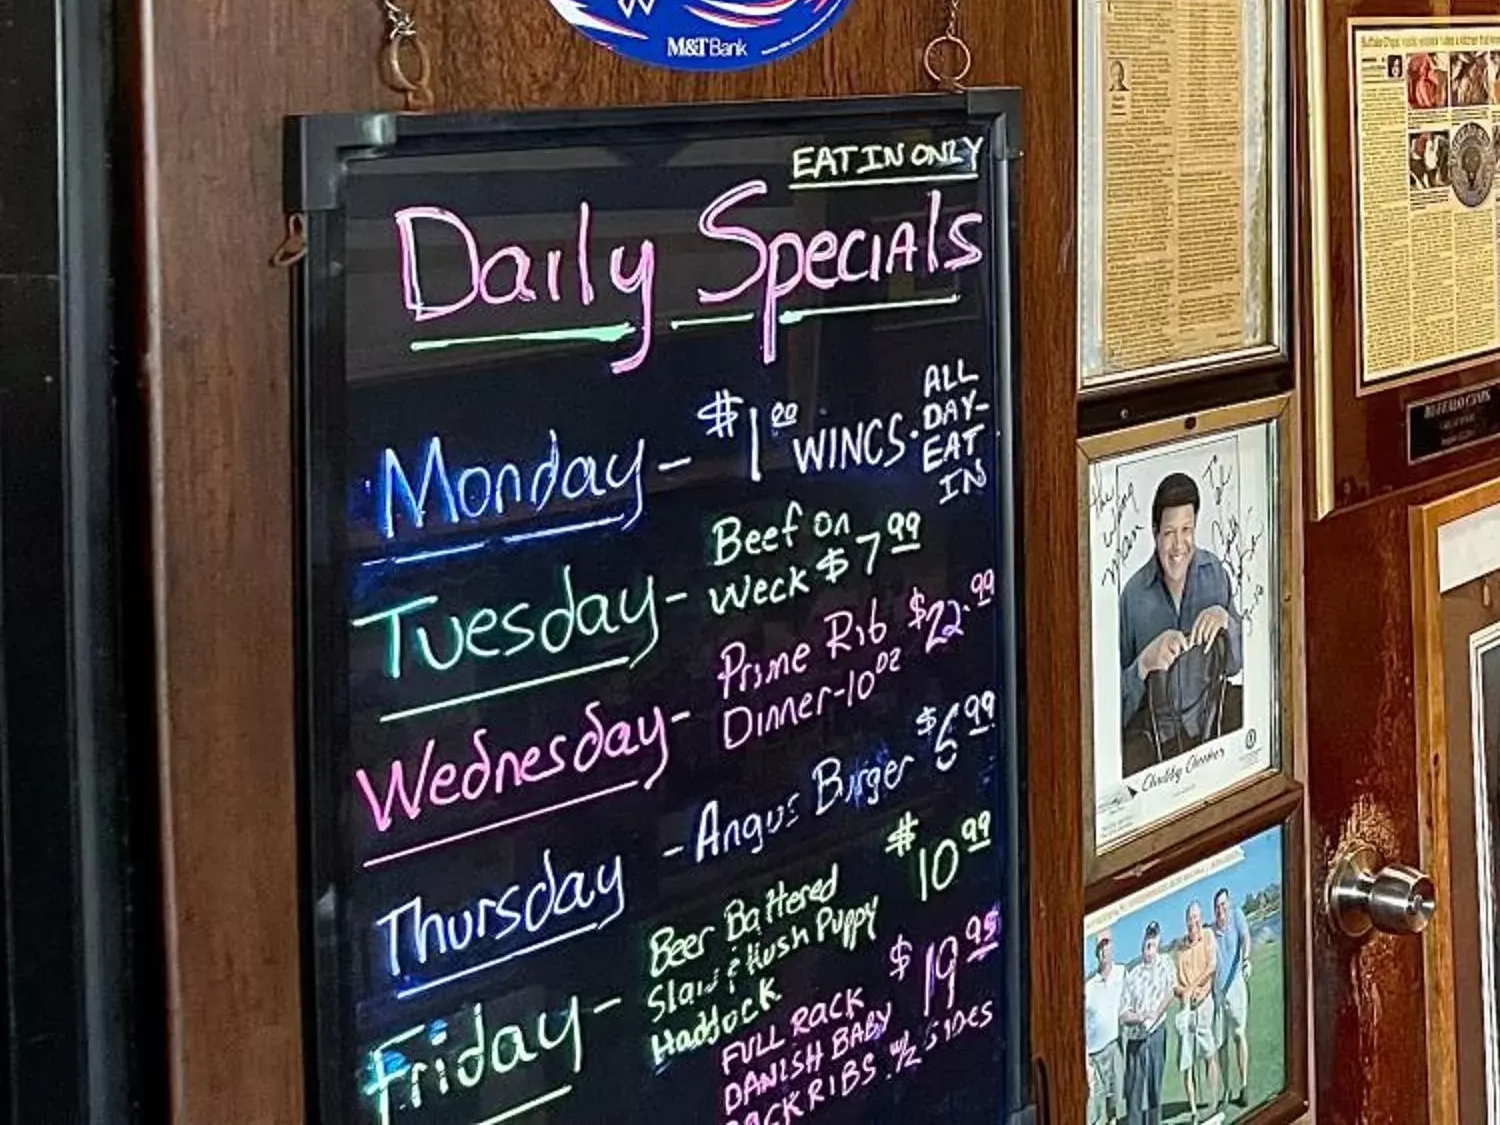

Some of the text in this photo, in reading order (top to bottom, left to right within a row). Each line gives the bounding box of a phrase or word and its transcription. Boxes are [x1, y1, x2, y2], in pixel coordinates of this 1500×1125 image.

[667, 37, 748, 57] M&T Bank
[792, 136, 985, 178] EAT IN ONLY
[397, 200, 655, 374] Daily
[699, 180, 983, 364] Specials
[923, 360, 978, 396] ALL
[923, 430, 978, 471] EAT
[940, 465, 988, 505] IN
[713, 505, 804, 566] Beef
[717, 642, 810, 700] Prime
[826, 607, 887, 653] Rib
[378, 850, 624, 977] Thursday
[813, 754, 914, 818] Burger
[650, 922, 715, 977] Beer
[725, 864, 838, 942] Battered
[817, 895, 879, 950] Puppy
[651, 977, 782, 1065] Haddock
[721, 1026, 786, 1075] FULL
[725, 1003, 891, 1115] DANISH BABY
[808, 1053, 876, 1110] RIBS
